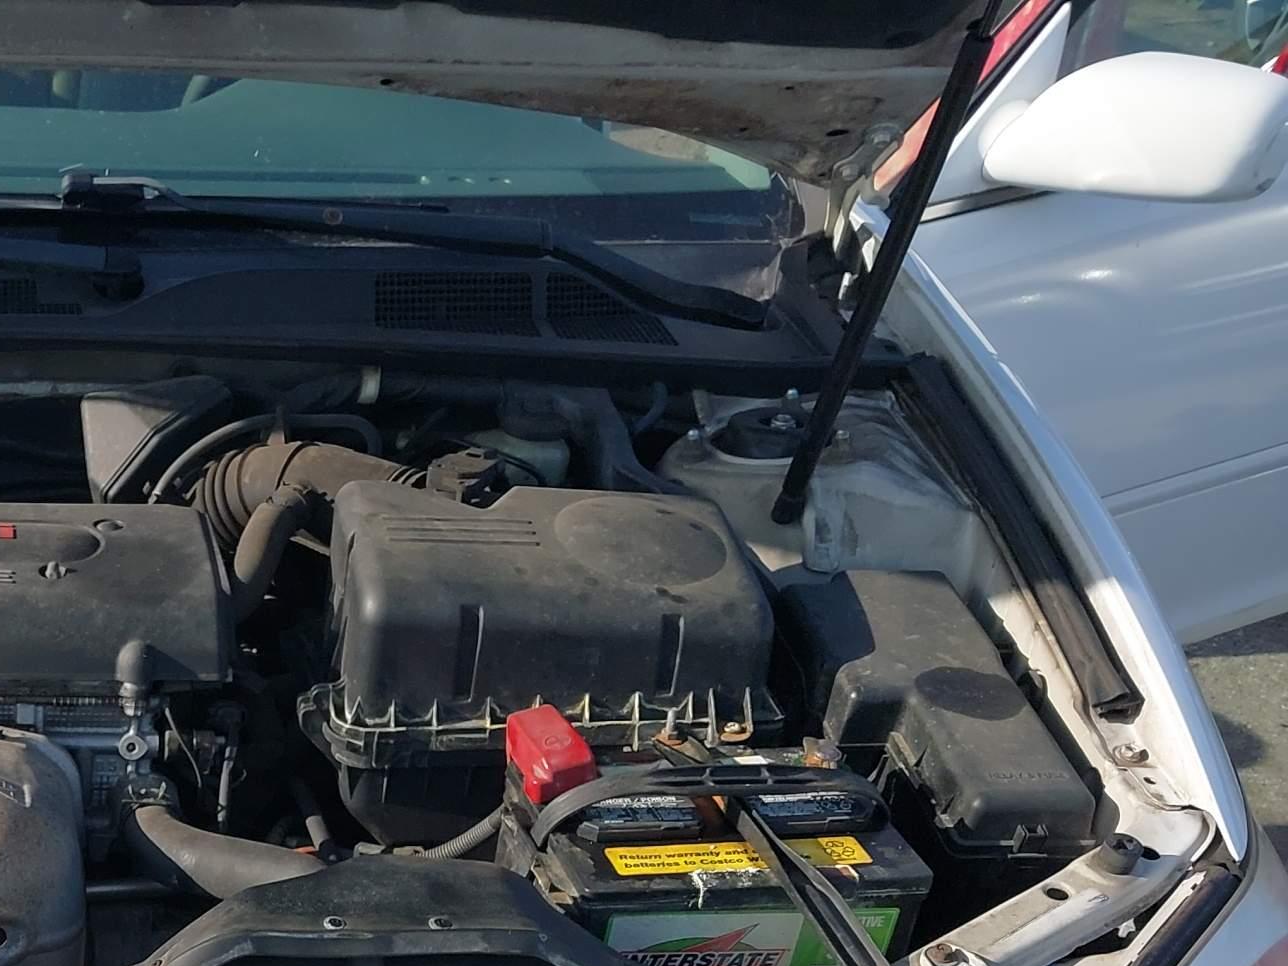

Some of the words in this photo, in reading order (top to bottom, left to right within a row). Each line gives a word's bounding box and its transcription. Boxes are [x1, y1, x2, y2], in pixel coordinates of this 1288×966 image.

[600, 797, 632, 807] ANGER
[619, 853, 661, 861] Return
[665, 850, 720, 859] warranty
[724, 848, 749, 857] and
[624, 859, 680, 869] batteries
[684, 858, 697, 867] to
[700, 856, 744, 866] Costco
